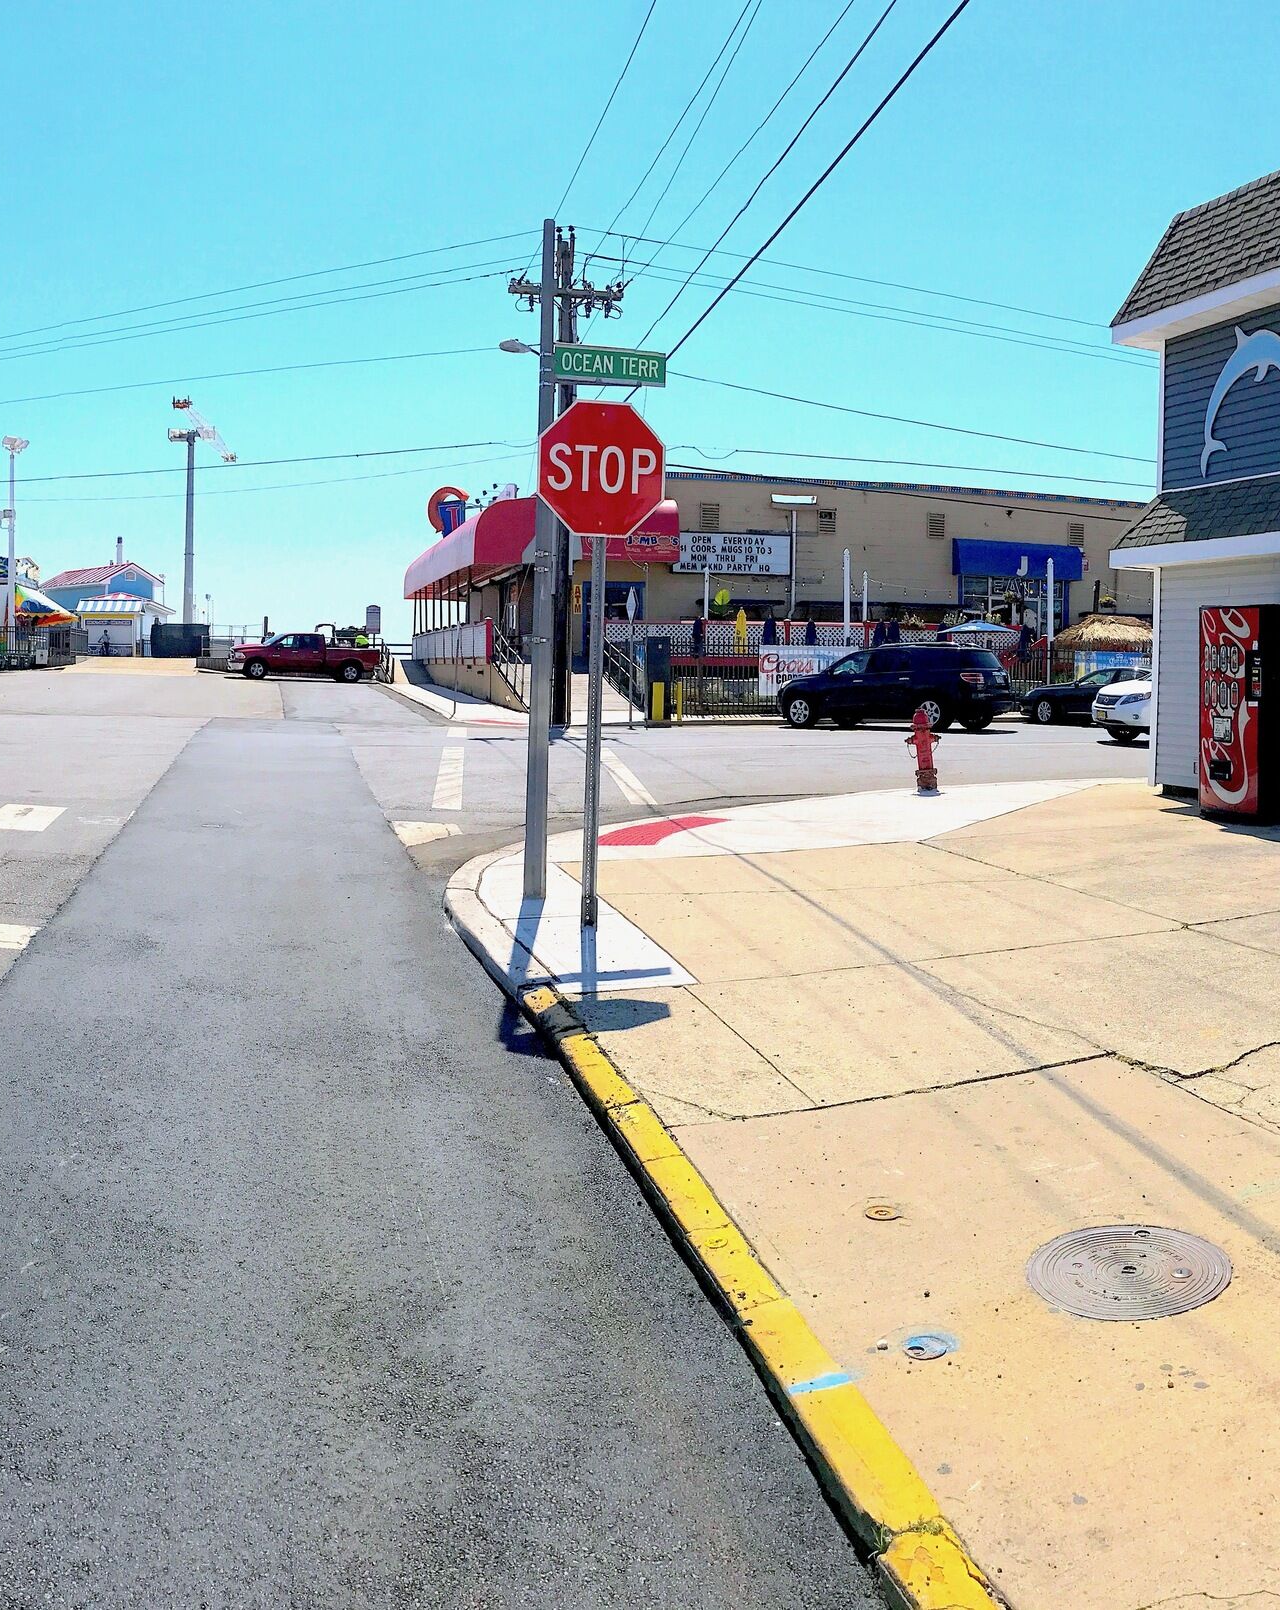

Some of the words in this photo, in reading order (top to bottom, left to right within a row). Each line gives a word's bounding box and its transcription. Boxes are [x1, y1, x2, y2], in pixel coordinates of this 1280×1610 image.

[561, 351, 614, 374] OCEAN
[620, 356, 659, 378] TERR
[547, 442, 657, 495] STOP
[690, 545, 717, 554] COORS
[721, 545, 743, 554] MUGS
[756, 546, 766, 555] TO
[767, 547, 773, 555] 3
[691, 535, 712, 544] OPEN
[723, 536, 765, 546] EVERYDAY
[679, 562, 698, 570] MEM
[726, 563, 753, 571] PARTY
[758, 564, 771, 573] HQ
[690, 554, 707, 562] MON
[716, 554, 736, 563] THRU
[745, 555, 759, 563] FRI
[1016, 555, 1029, 577] J
[574, 585, 582, 614] ATM
[760, 653, 814, 674] Coors
